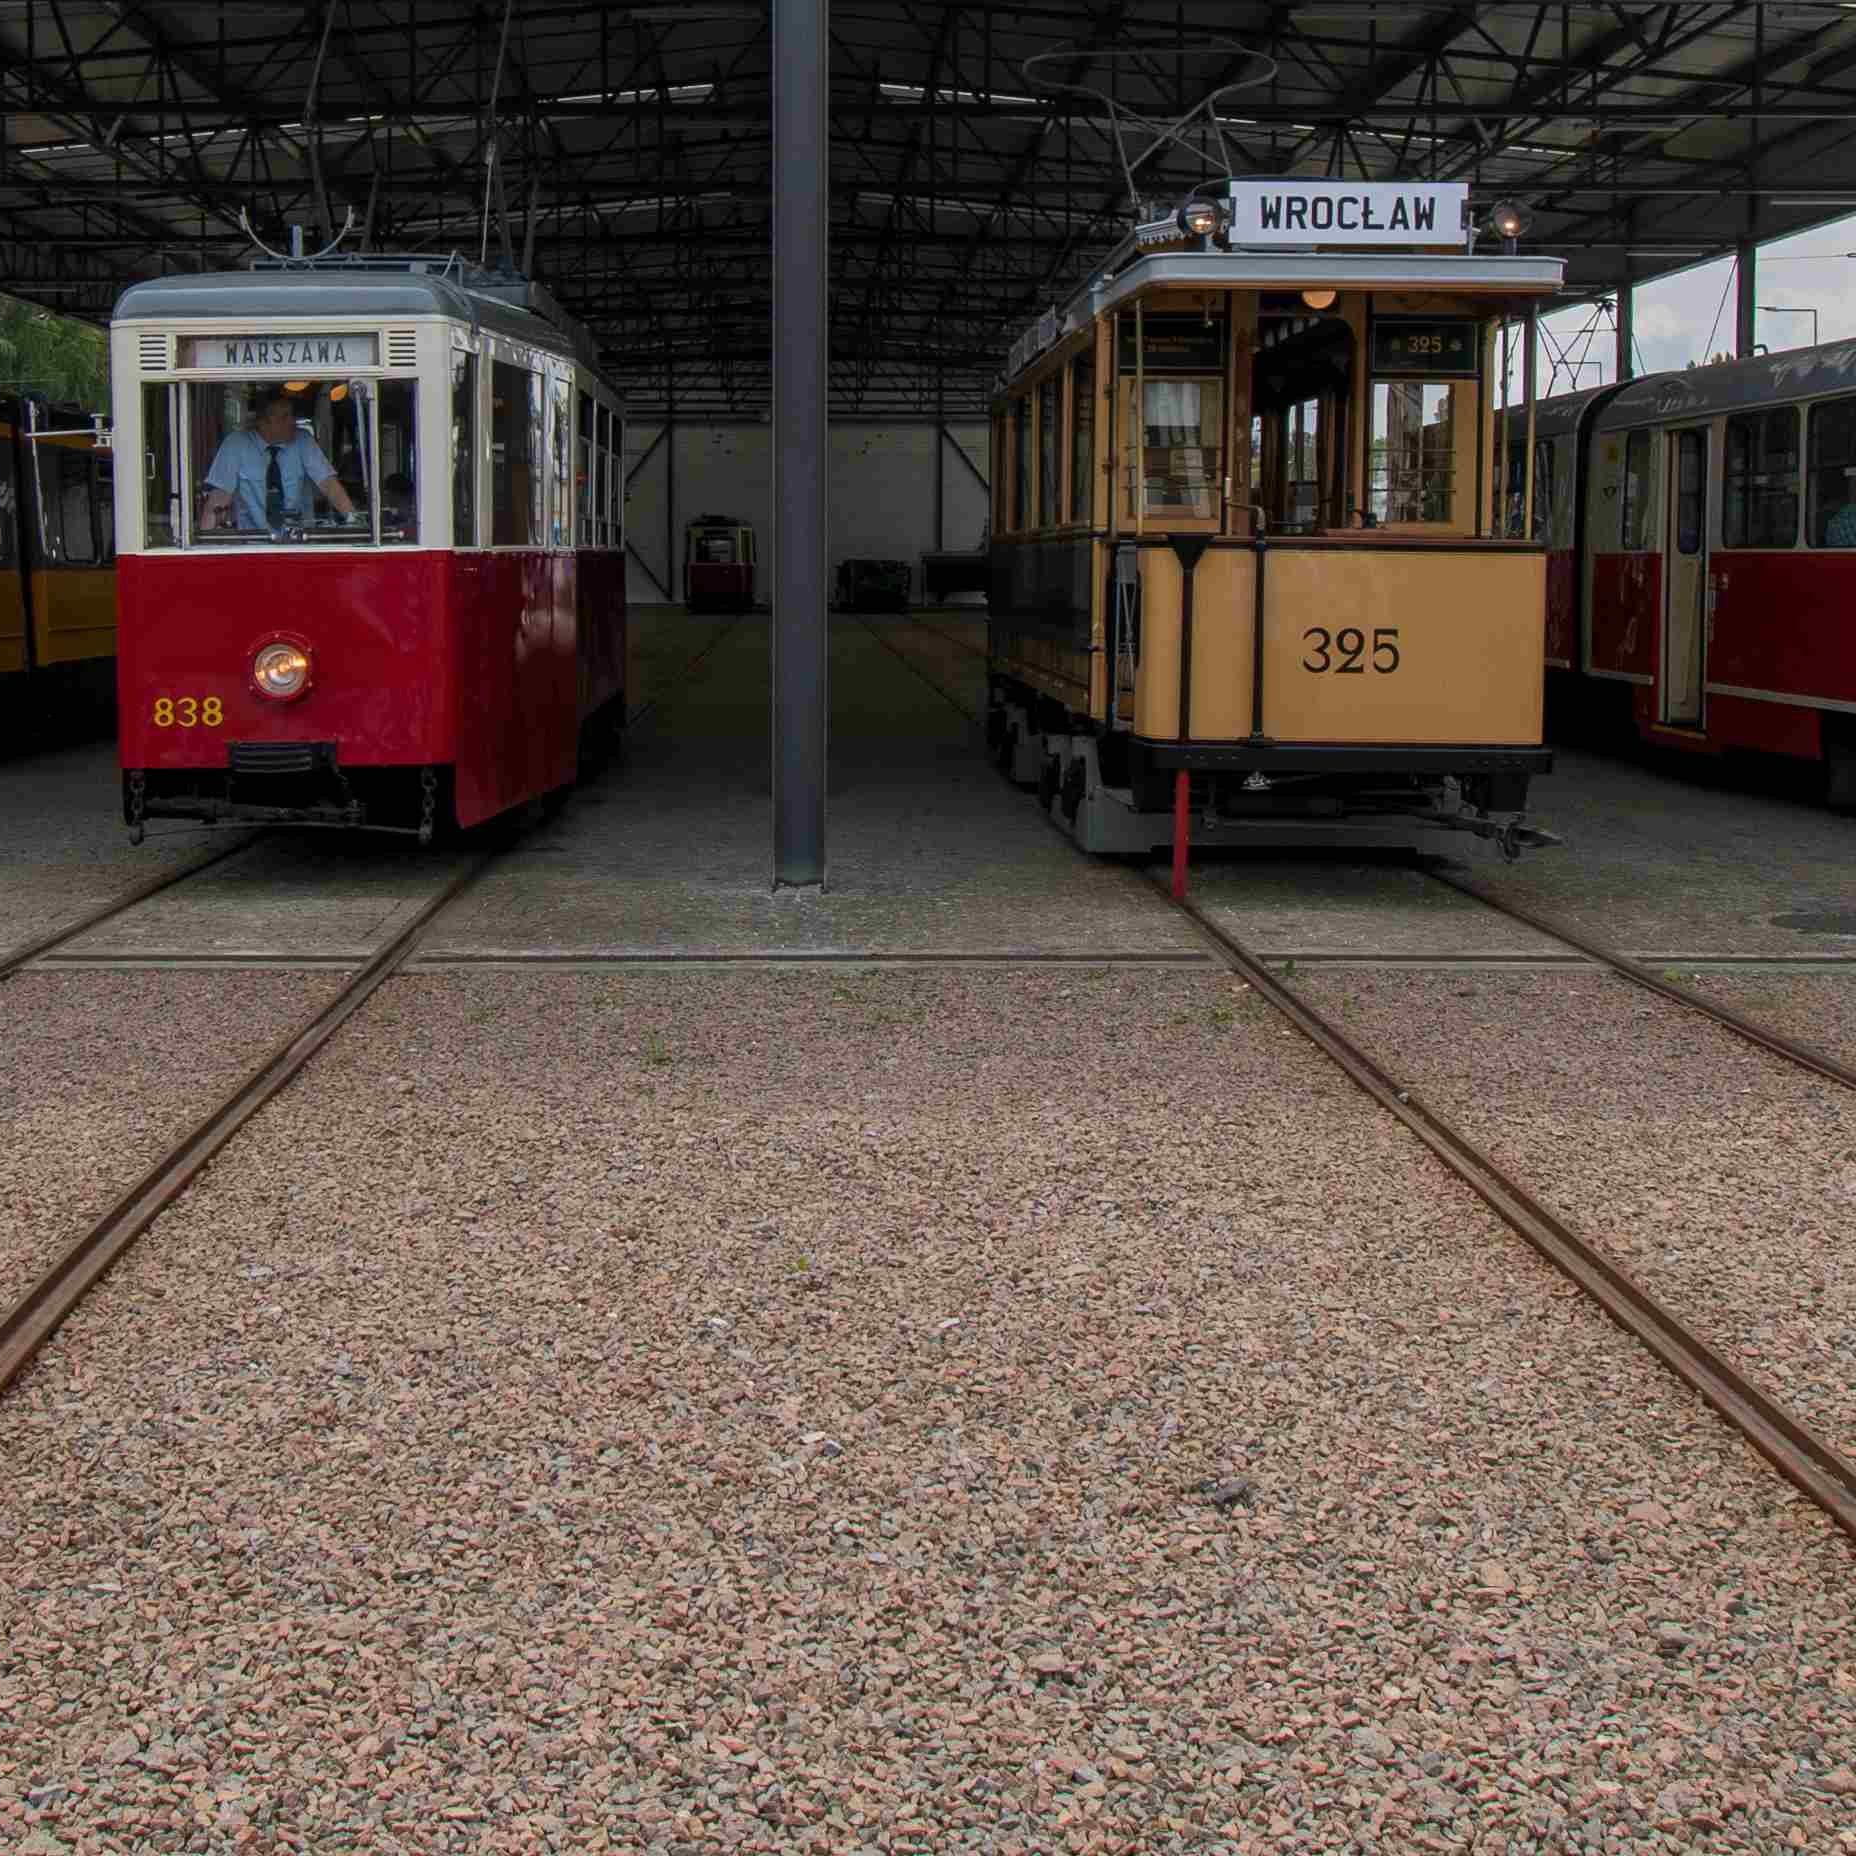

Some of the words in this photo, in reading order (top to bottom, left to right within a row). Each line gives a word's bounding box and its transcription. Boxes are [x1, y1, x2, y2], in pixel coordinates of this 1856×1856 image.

[1260, 196, 1436, 230] WROCŁAW
[225, 341, 347, 364] WARSZAWA
[1407, 336, 1442, 353] 325
[1301, 627, 1401, 673] 325
[153, 696, 224, 729] 838
